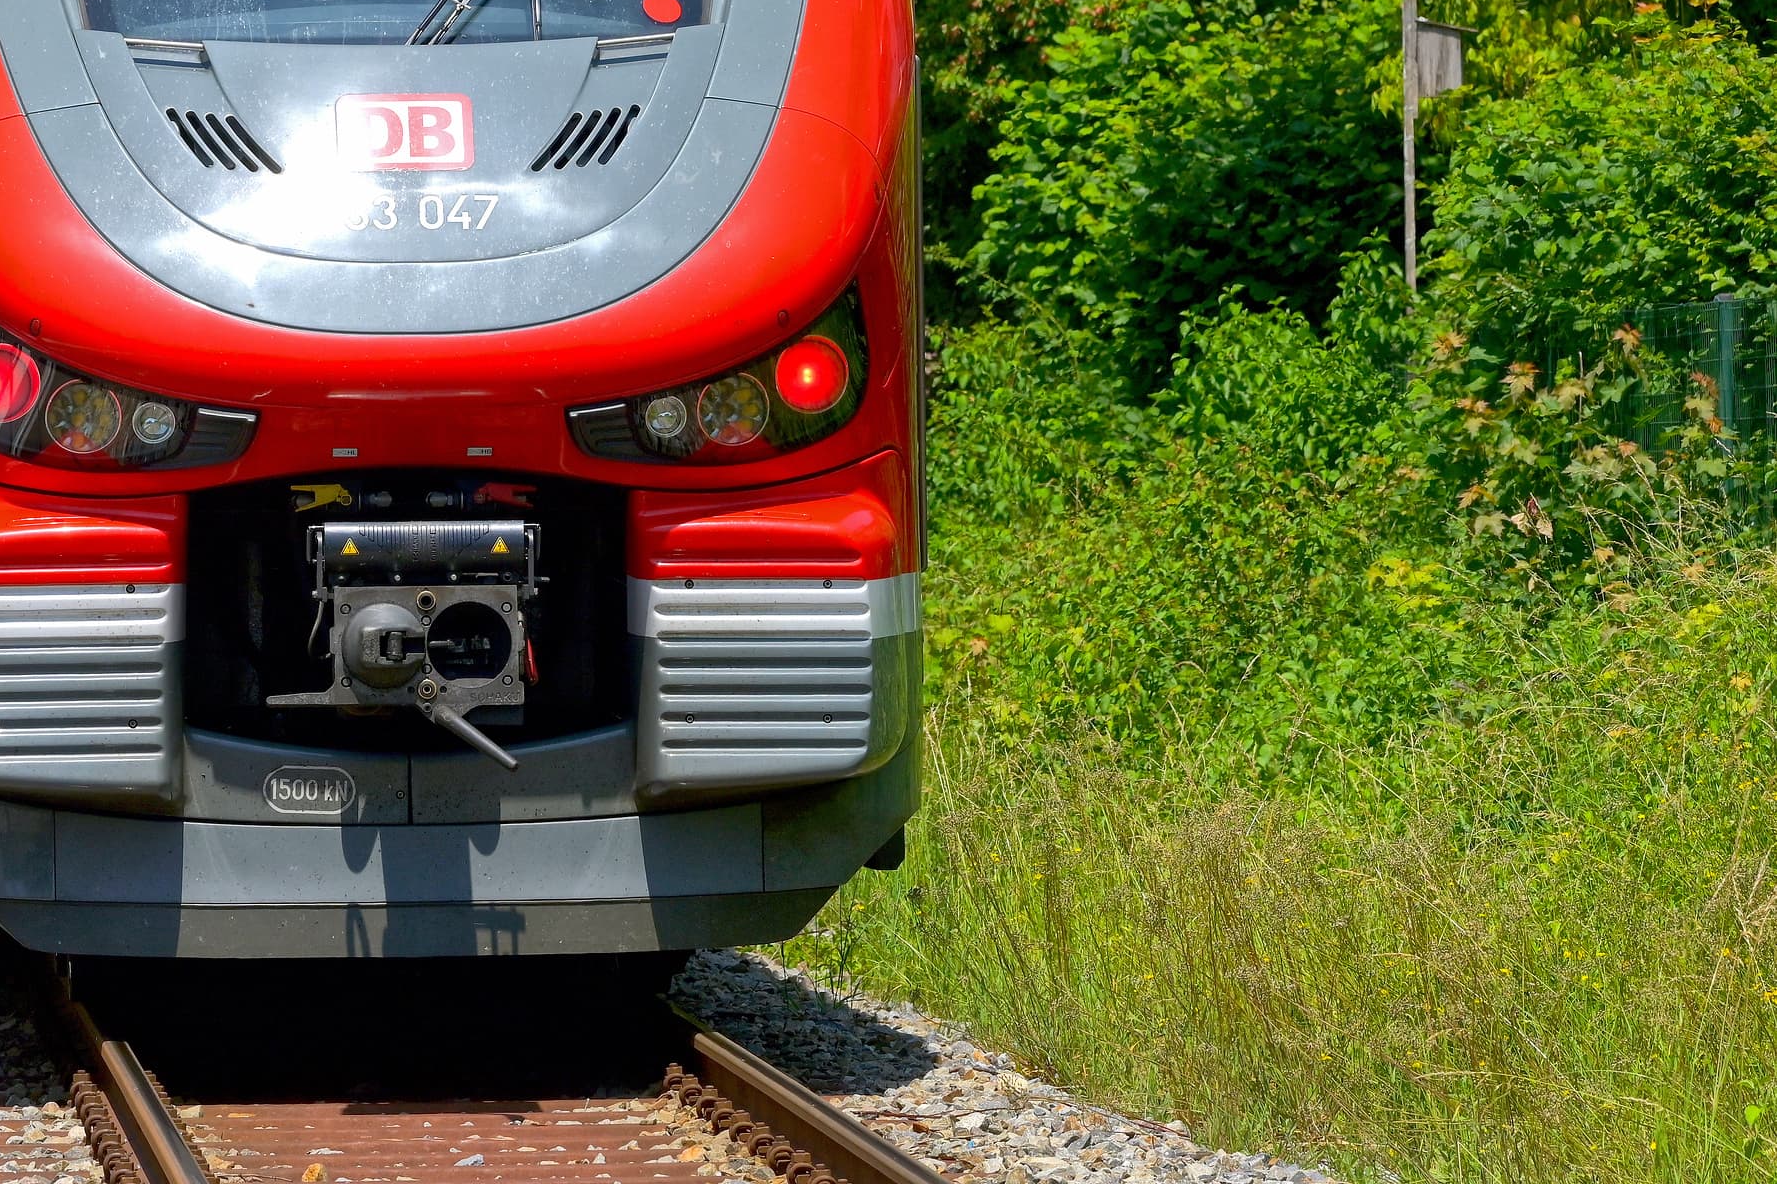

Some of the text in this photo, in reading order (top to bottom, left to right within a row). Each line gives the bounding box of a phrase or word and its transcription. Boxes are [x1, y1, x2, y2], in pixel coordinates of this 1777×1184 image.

[361, 105, 456, 158] DB
[418, 194, 500, 232] 047
[270, 778, 349, 802] 1500 kN
